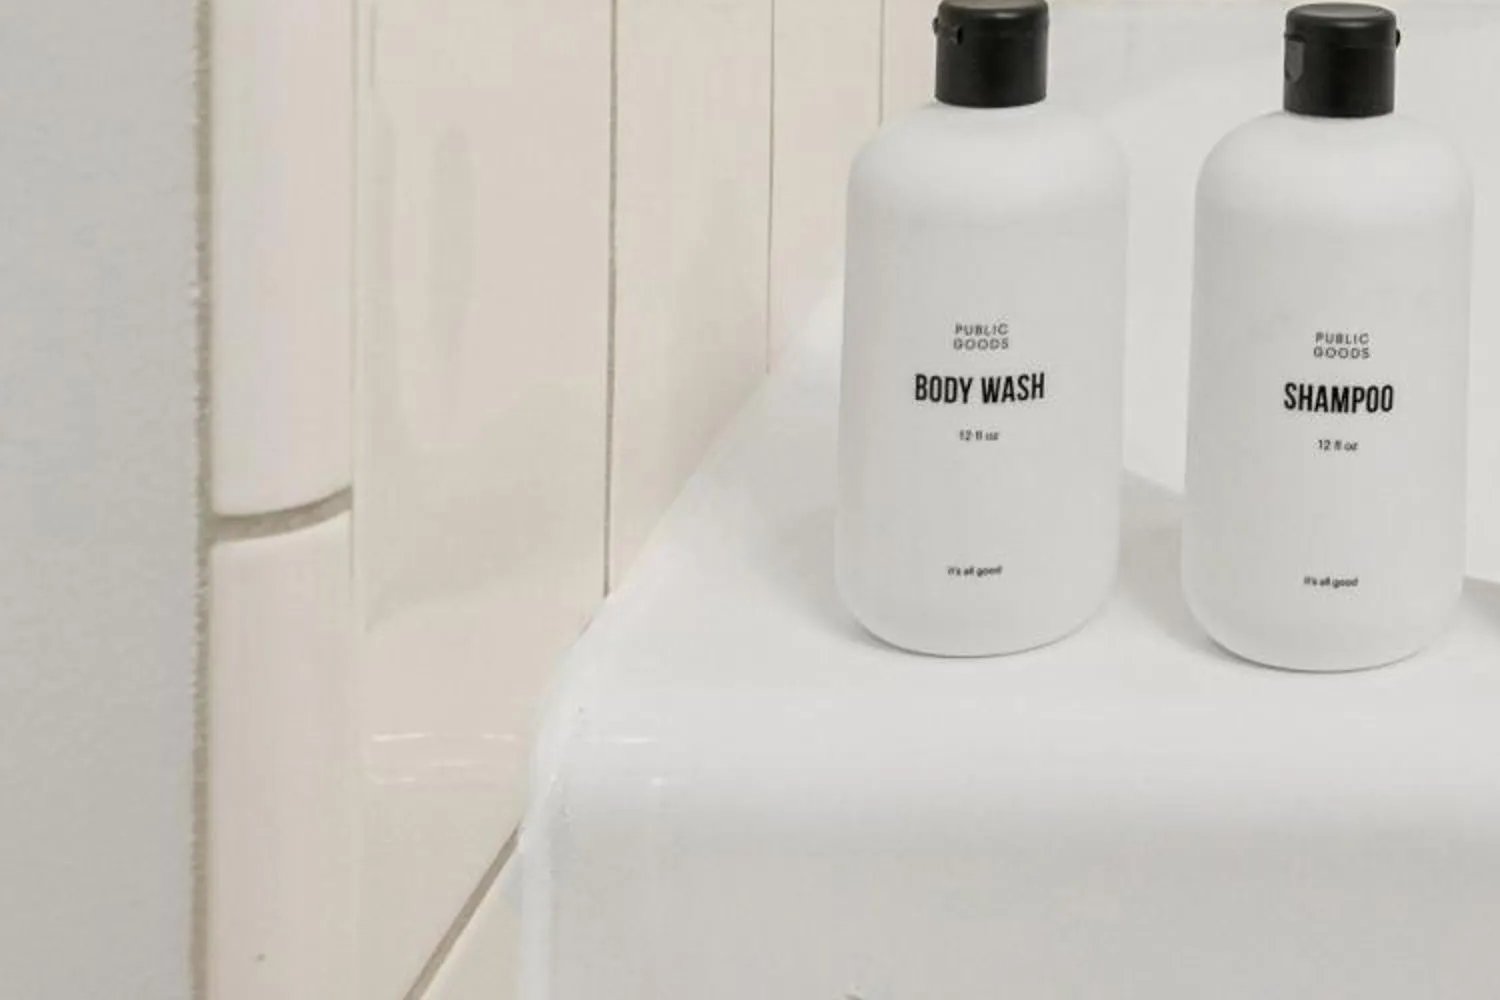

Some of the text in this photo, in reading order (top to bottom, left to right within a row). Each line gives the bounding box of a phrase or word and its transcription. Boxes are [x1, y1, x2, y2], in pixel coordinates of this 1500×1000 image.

[954, 322, 1009, 337] PUBLIC
[952, 337, 1009, 351] GOODS
[1315, 331, 1369, 345] PUBLIC
[1312, 345, 1371, 360] GOODS
[913, 370, 1046, 405] BODY WASH
[1282, 381, 1395, 415] SHAMPOO
[959, 429, 999, 442] 12 fl oz
[1317, 438, 1359, 452] 12 fl oz
[963, 565, 975, 577] all
[976, 565, 1003, 578] good
[1319, 577, 1331, 588] all
[1332, 577, 1359, 590] good
